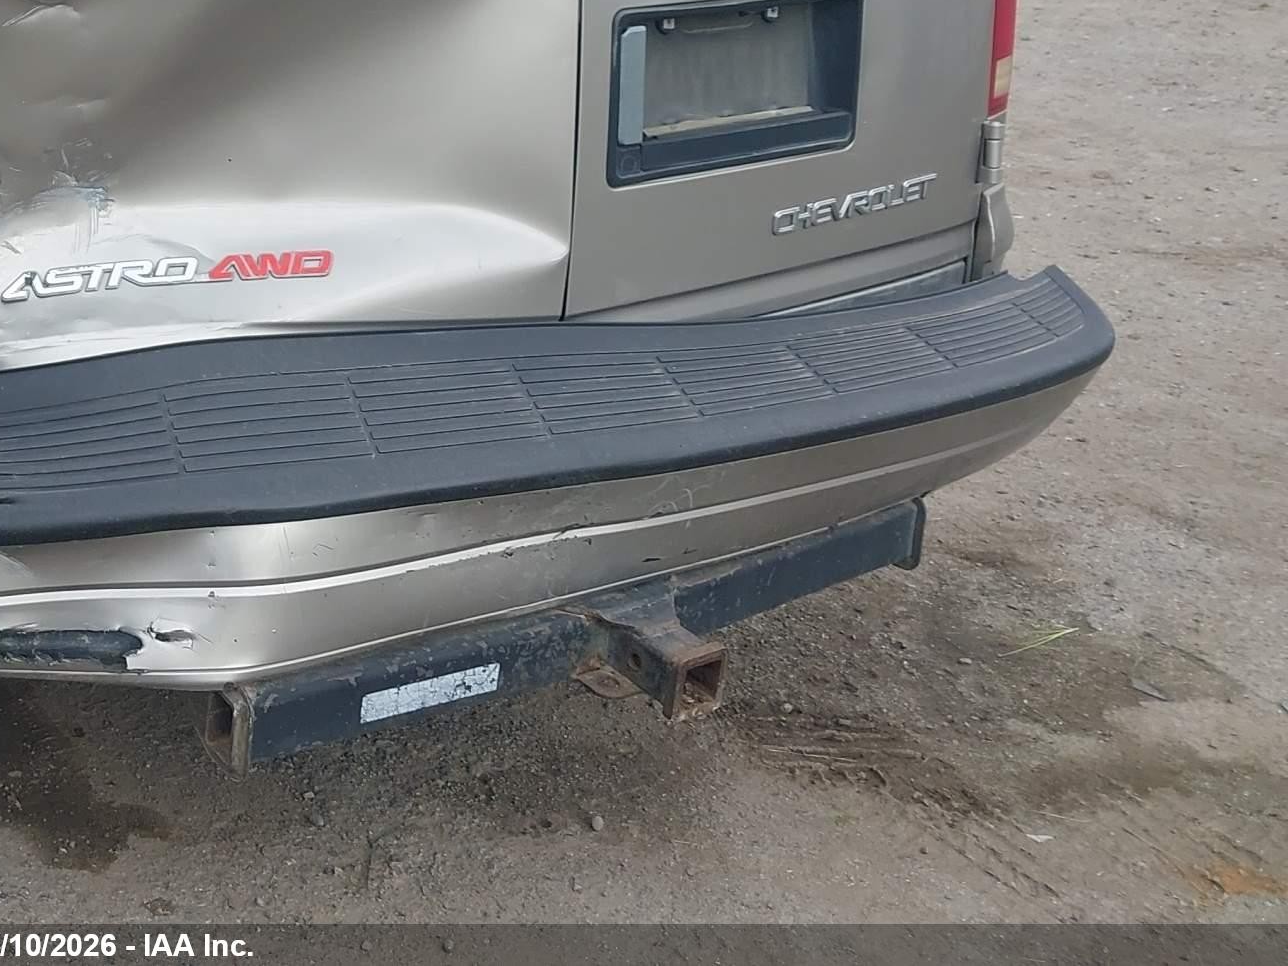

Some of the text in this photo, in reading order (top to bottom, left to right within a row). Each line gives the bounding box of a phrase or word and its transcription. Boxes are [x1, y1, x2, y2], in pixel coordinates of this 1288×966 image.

[772, 173, 938, 236] CHEVROLET
[0, 250, 333, 303] ASTRO AWD
